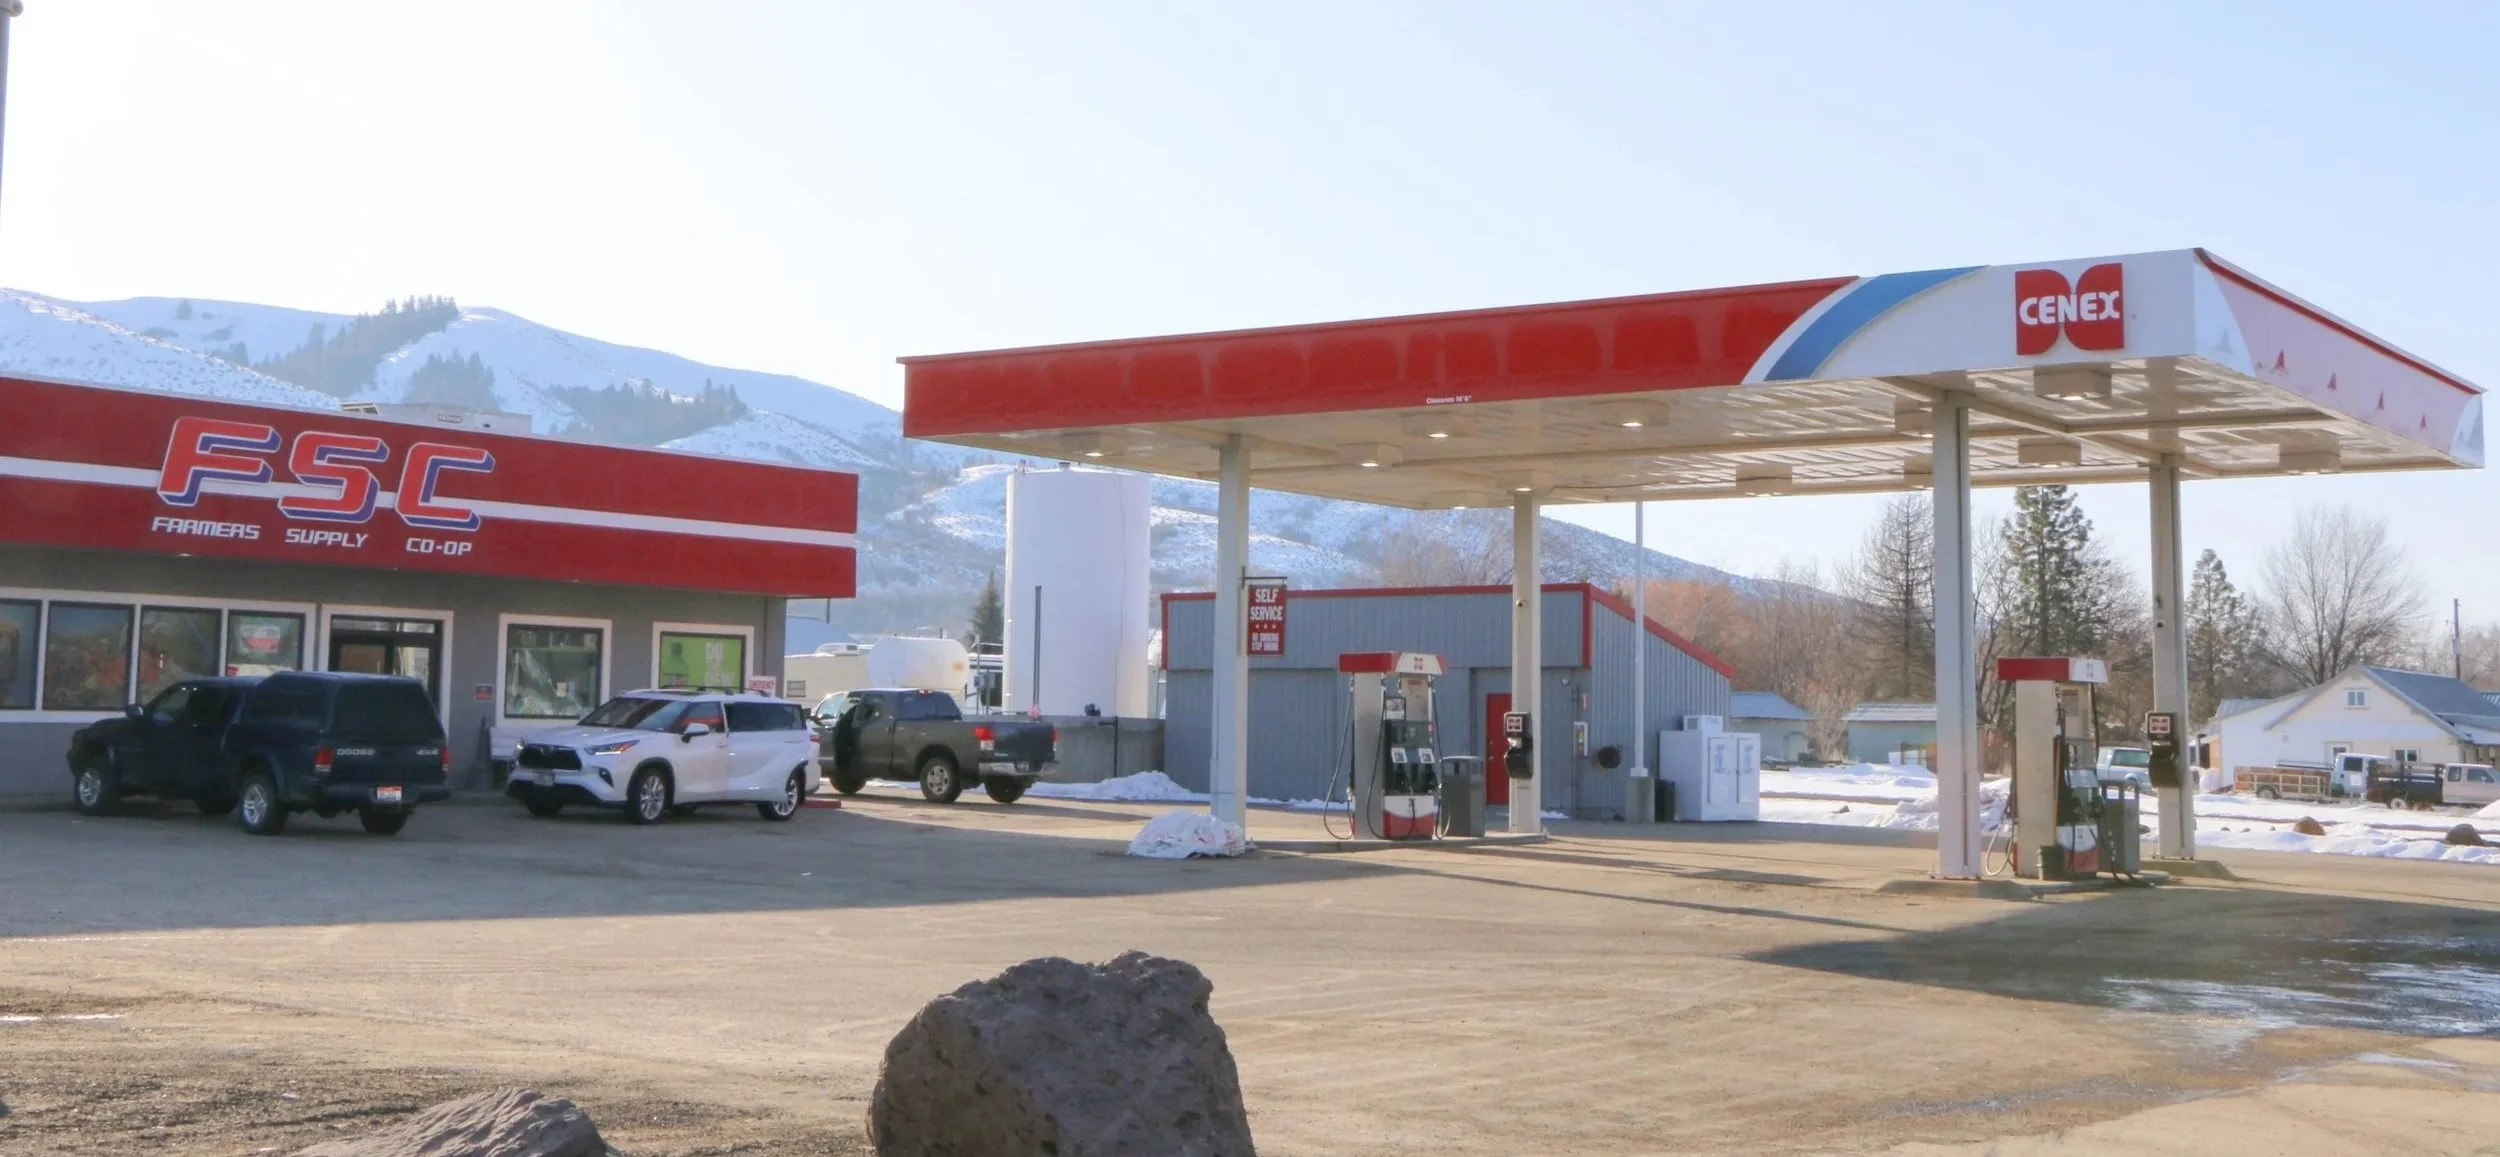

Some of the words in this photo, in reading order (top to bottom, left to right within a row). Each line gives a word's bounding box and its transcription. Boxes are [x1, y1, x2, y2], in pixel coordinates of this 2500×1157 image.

[2020, 290, 2120, 325] CENEX
[157, 416, 496, 532] FSC
[152, 516, 262, 540] FARMERS
[284, 528, 368, 549] SUPPLY
[405, 537, 472, 556] CO-OP
[1255, 588, 1279, 603] SELF
[1250, 606, 1283, 621] SERVICE
[337, 748, 375, 756] DODGE
